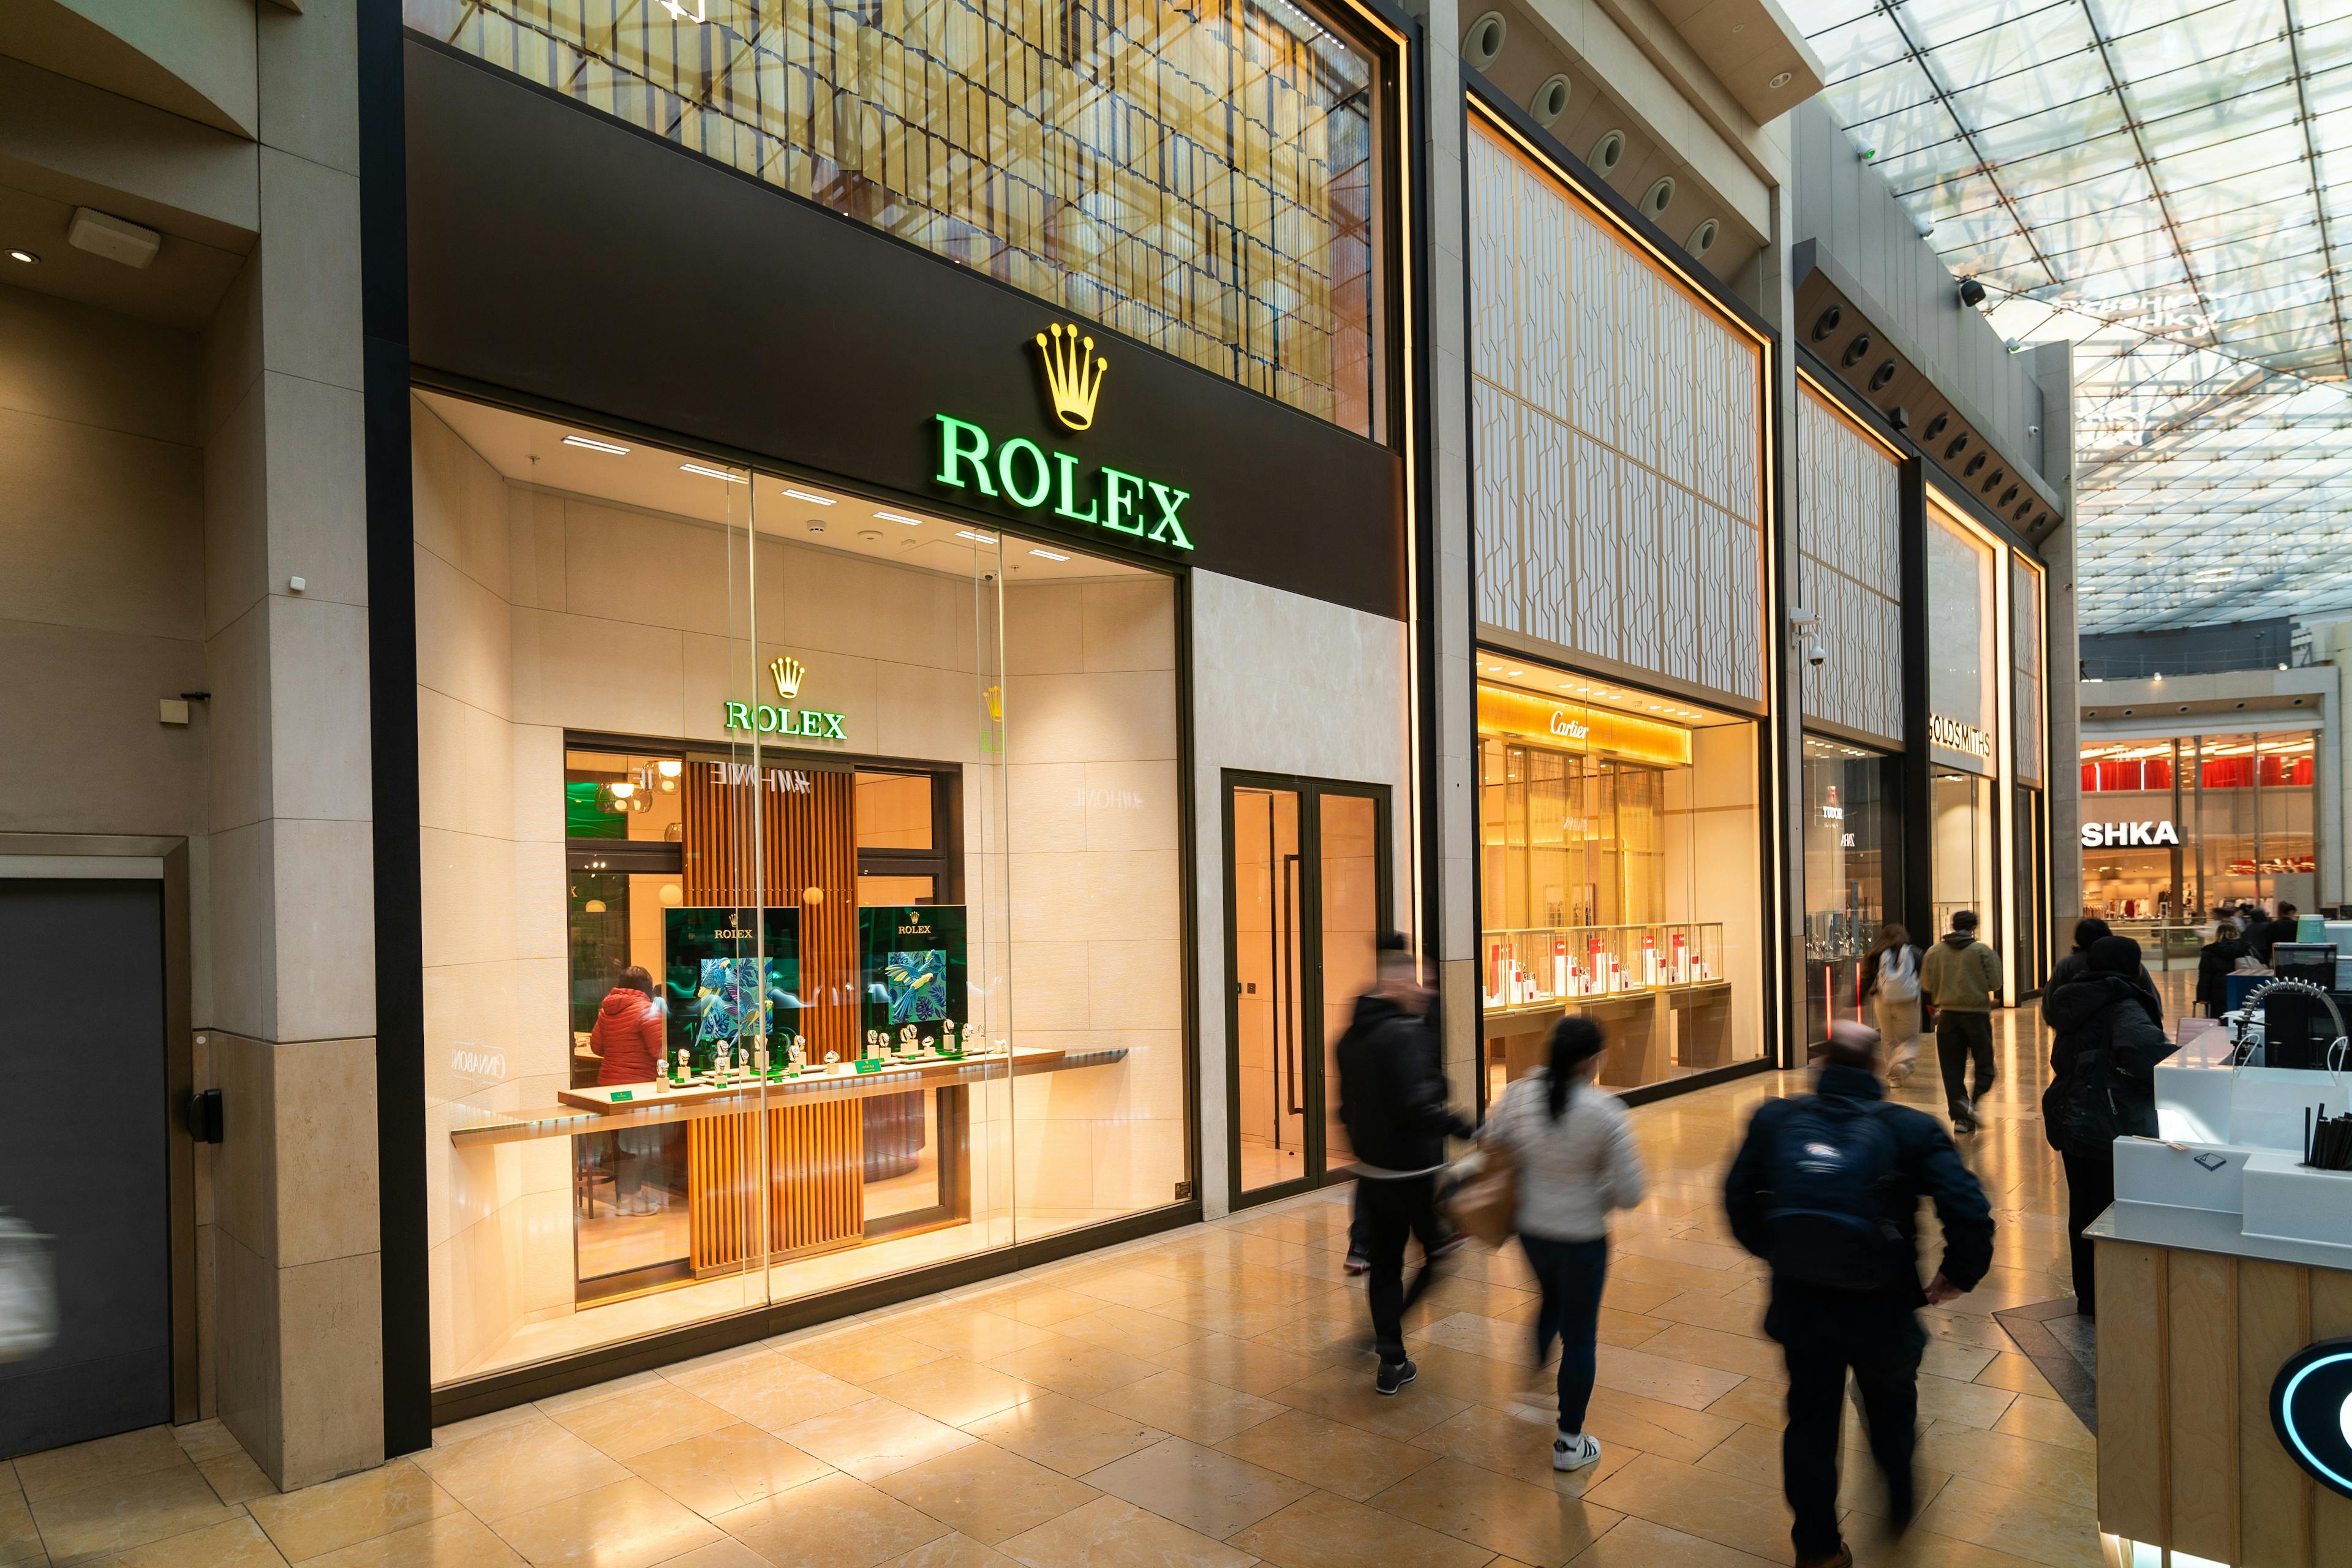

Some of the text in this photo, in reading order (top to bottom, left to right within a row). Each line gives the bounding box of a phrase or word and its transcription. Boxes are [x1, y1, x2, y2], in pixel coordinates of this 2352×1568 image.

[934, 413, 1194, 551] ROLEX
[725, 701, 848, 740] ROLEX
[1550, 710, 1589, 739] Cartier
[1822, 806, 1843, 820] TUDOR
[2081, 821, 2179, 847] SHKA
[714, 929, 753, 939] ROLEX
[898, 925, 931, 934] ROLEX
